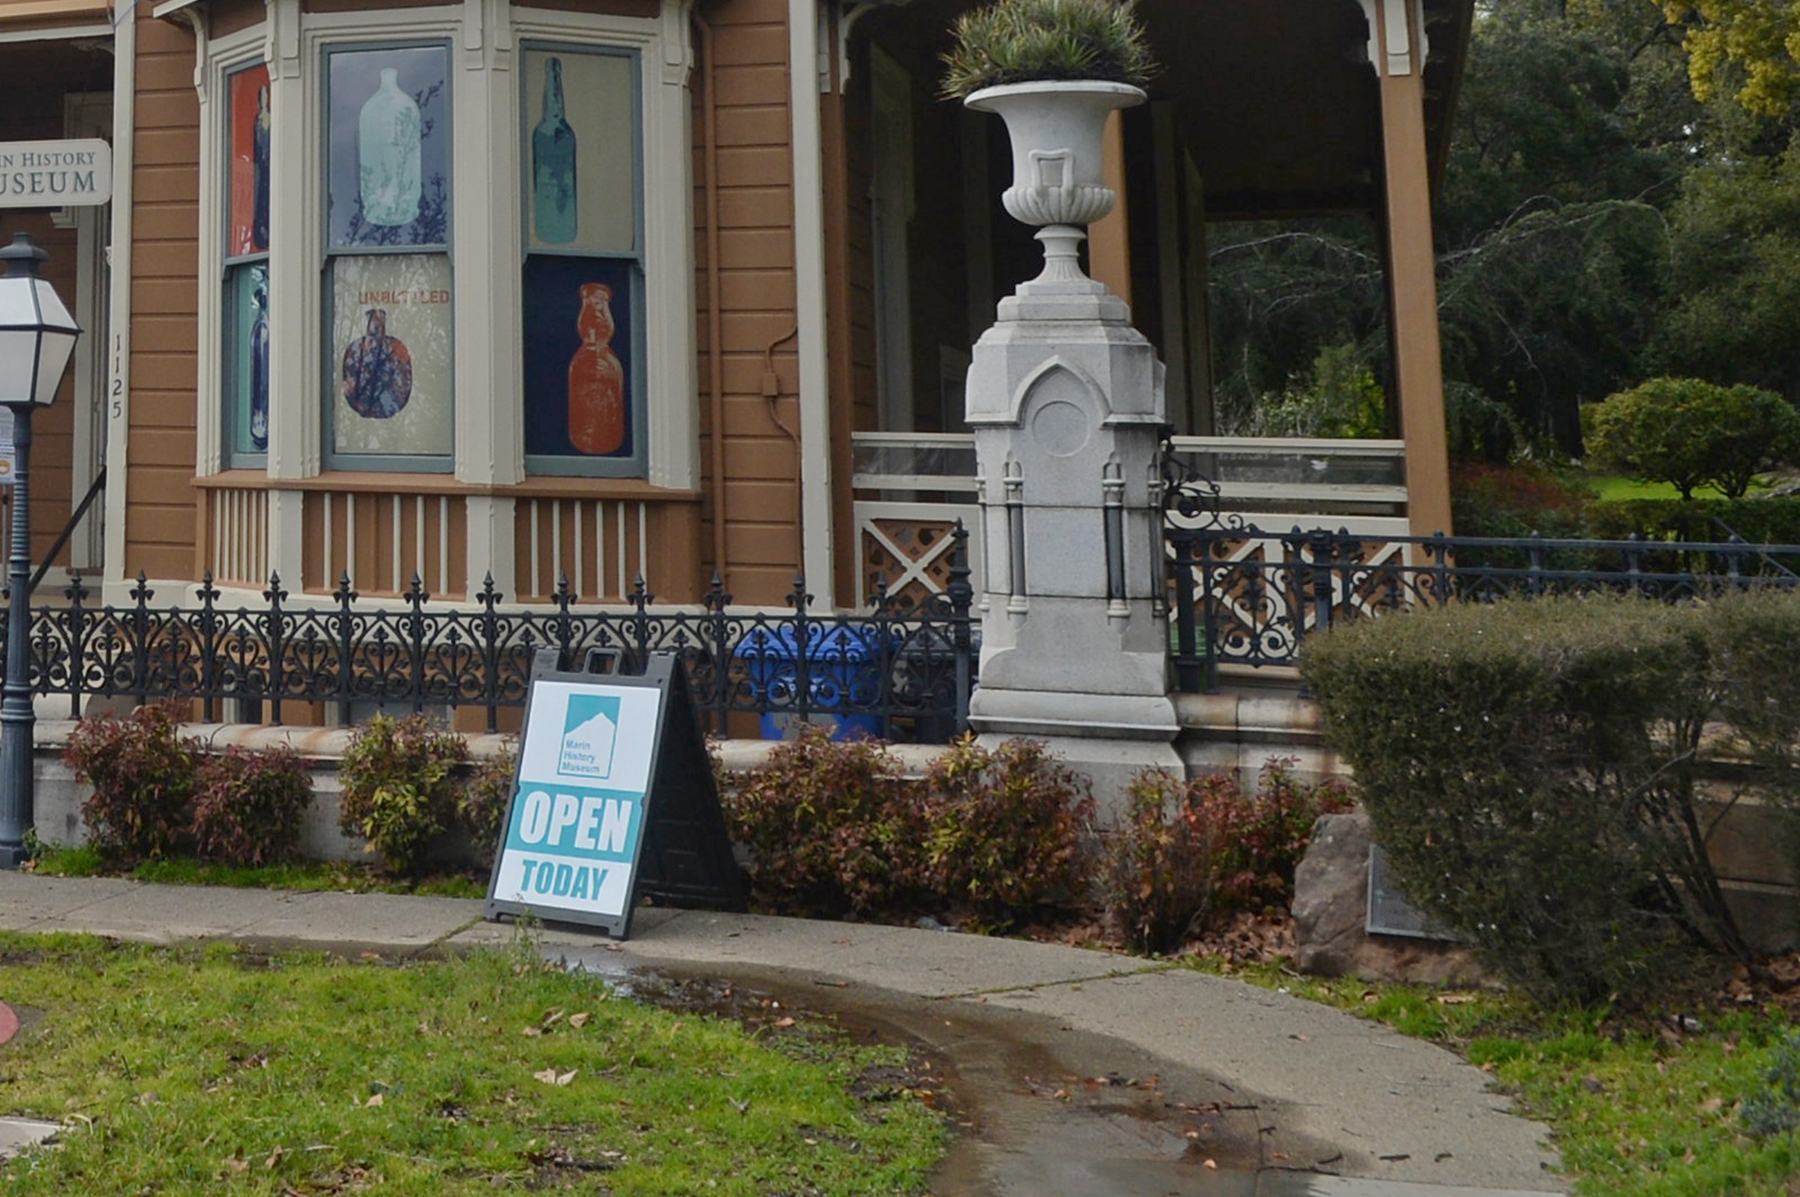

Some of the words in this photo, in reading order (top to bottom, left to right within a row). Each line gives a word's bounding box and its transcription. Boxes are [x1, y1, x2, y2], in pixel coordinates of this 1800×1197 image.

[22, 151, 96, 167] HISTORY
[112, 333, 123, 419] 1125
[565, 739, 591, 750] Marin
[563, 750, 595, 764] History
[561, 761, 600, 774] Museum
[518, 790, 633, 853] OPEN
[520, 859, 609, 901] TODAY
